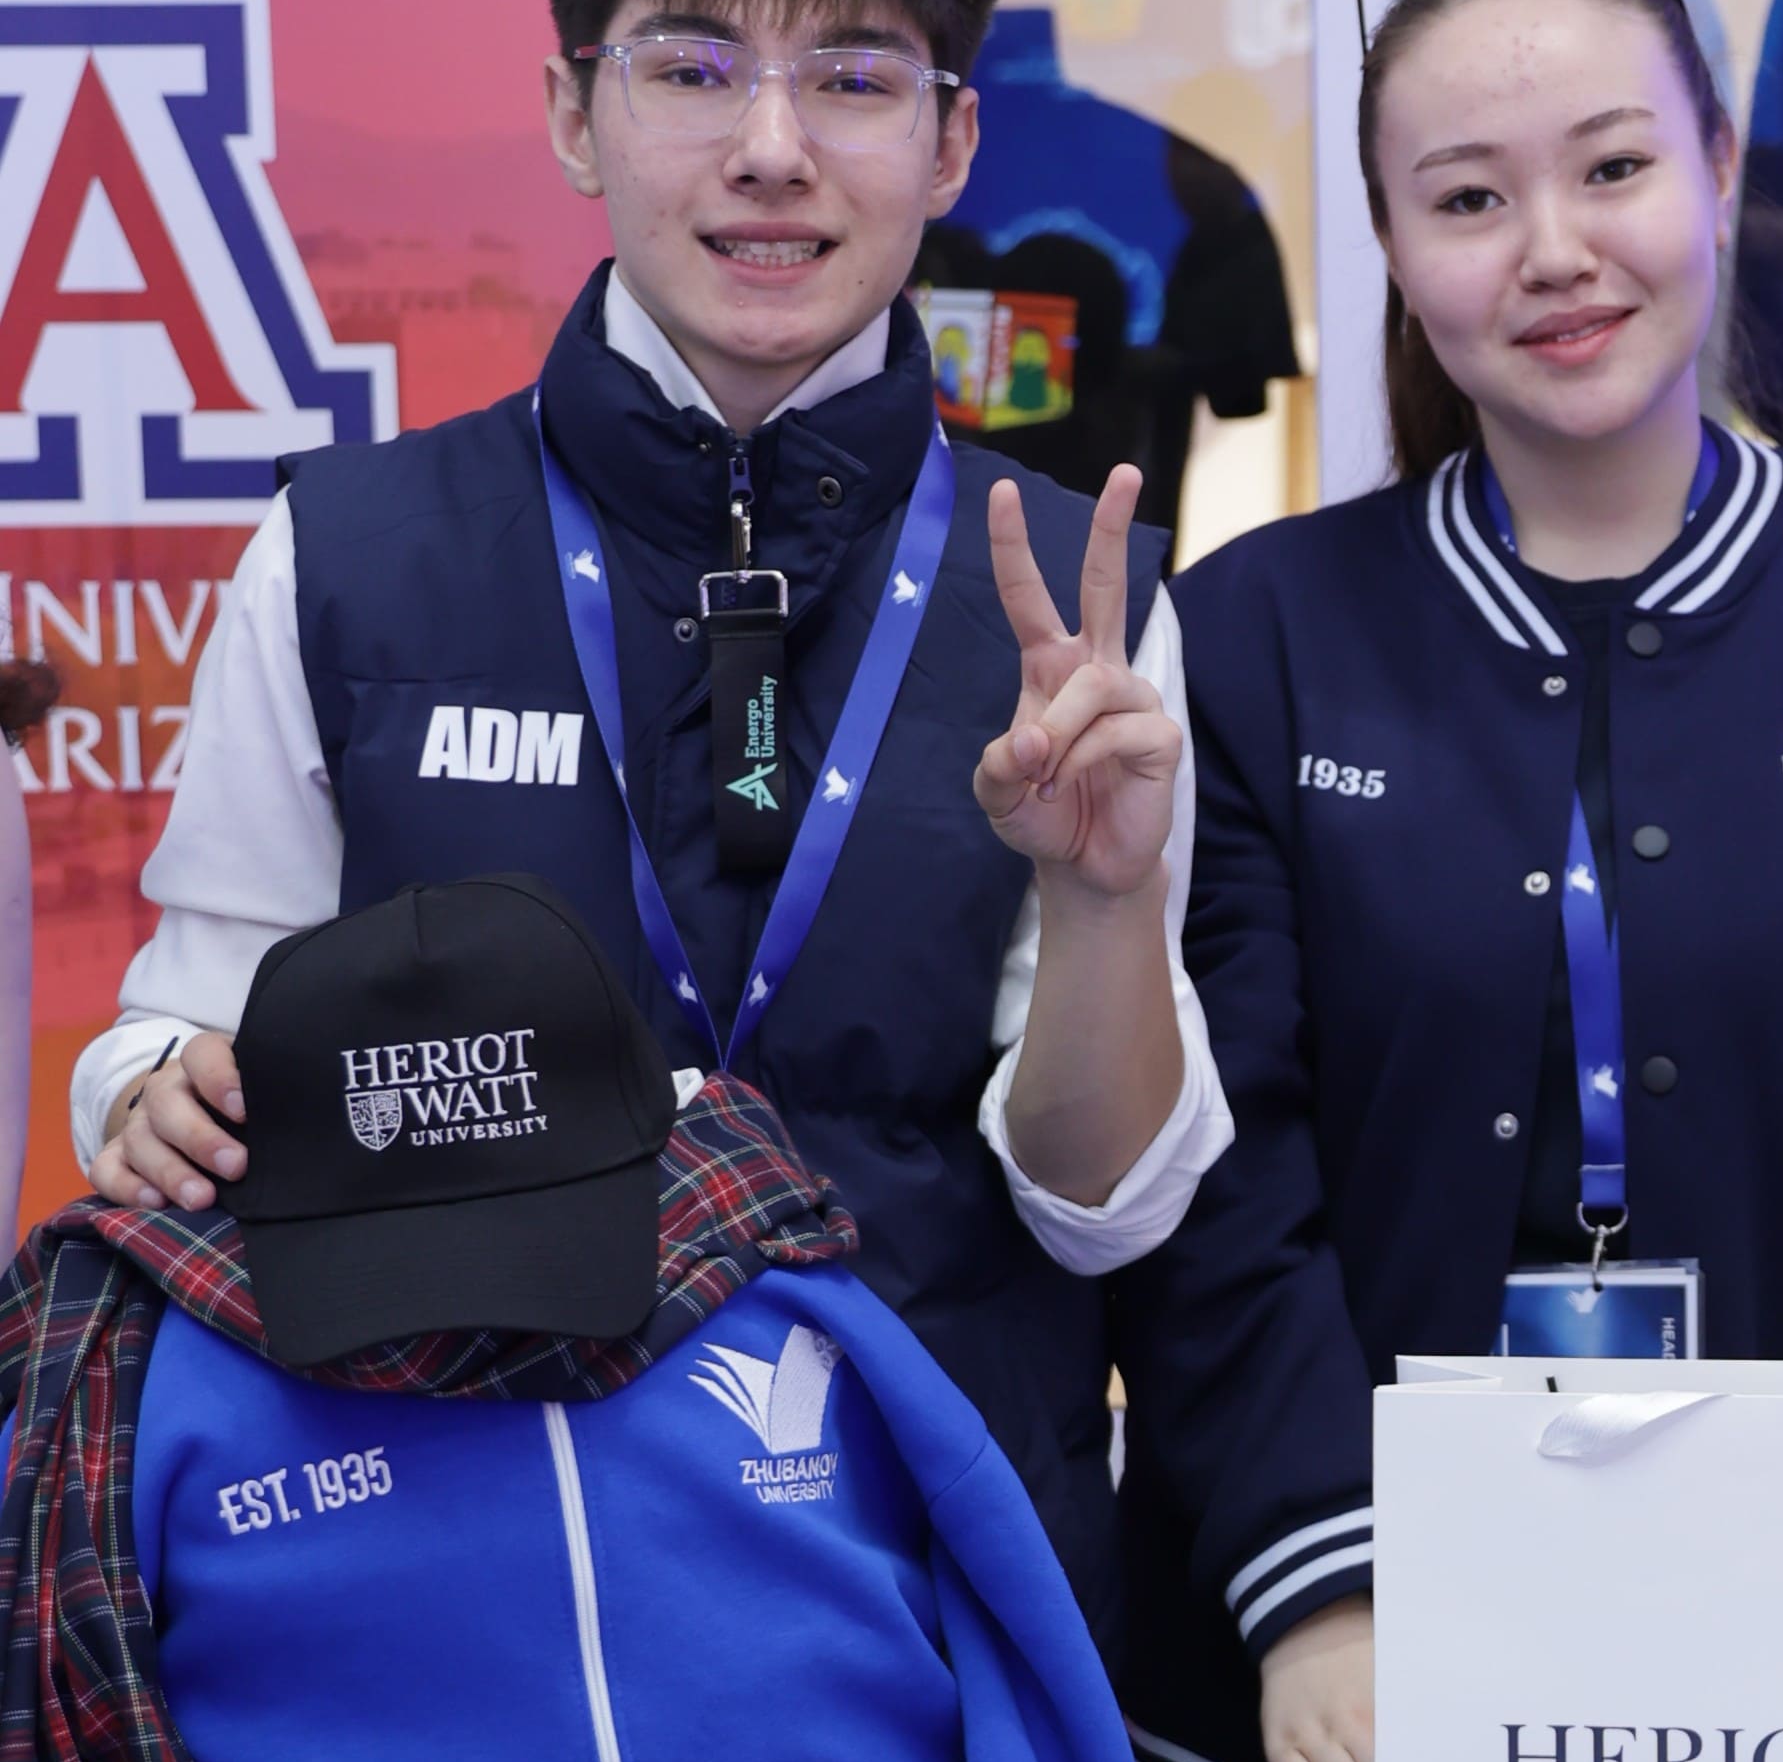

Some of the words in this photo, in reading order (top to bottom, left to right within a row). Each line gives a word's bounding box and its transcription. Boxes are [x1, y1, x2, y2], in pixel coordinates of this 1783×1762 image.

[744, 698, 760, 759] Energo
[760, 675, 779, 758] University
[418, 705, 584, 787] ADM
[1297, 754, 1386, 799] 1935
[340, 1028, 535, 1091] HERIOT
[403, 1071, 538, 1126] WATT
[410, 1114, 549, 1146] UNIVERSITY
[217, 1468, 302, 1536] EST.
[303, 1446, 394, 1514] 1935
[739, 1452, 839, 1486] ZHUBANOV
[756, 1479, 836, 1505] UNIVERSITY
